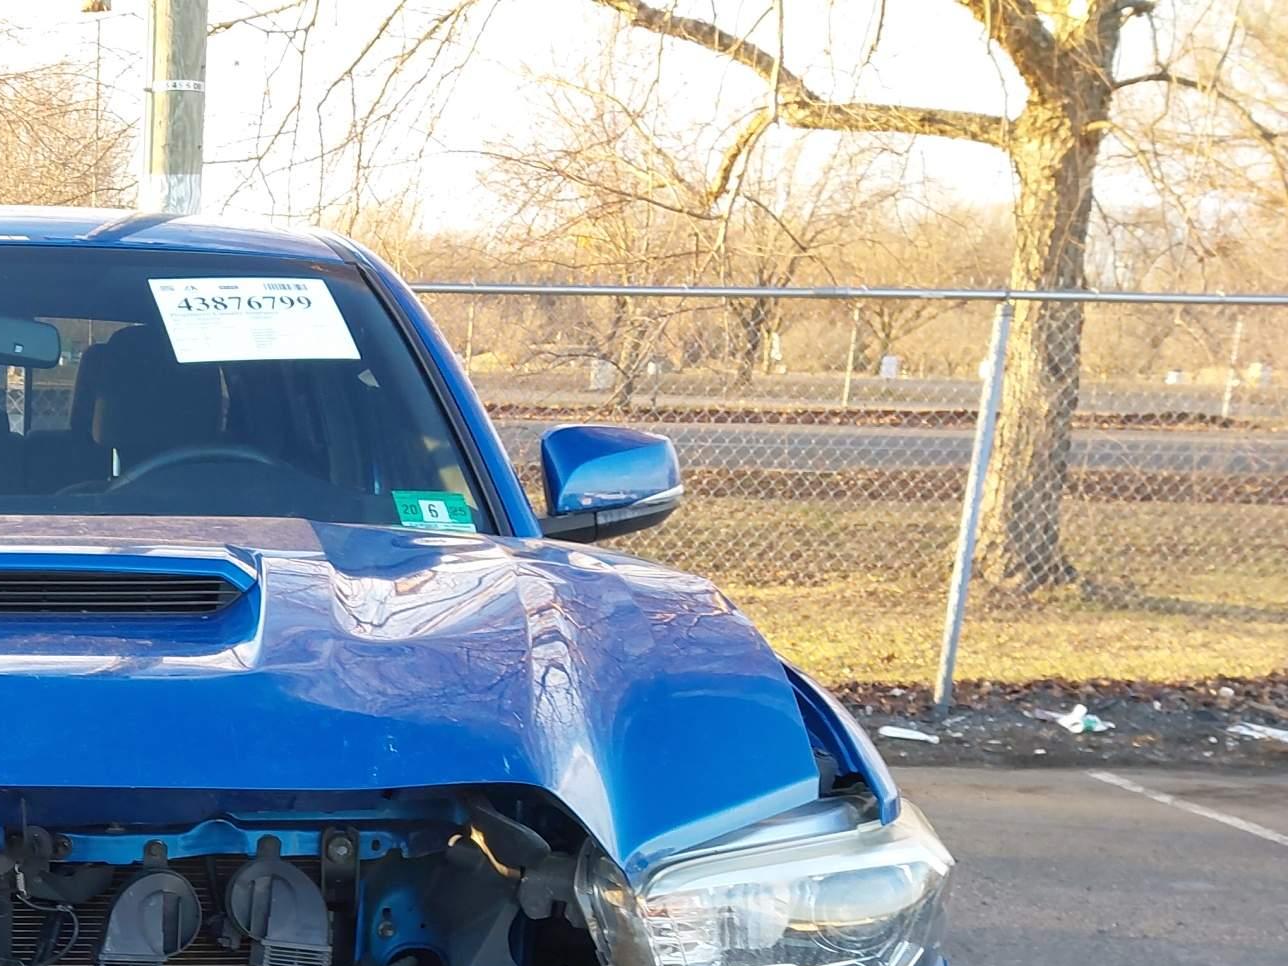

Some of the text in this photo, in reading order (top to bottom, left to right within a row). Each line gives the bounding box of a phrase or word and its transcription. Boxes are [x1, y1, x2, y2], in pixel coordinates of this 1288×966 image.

[177, 295, 313, 312] 43876799
[401, 504, 418, 515] 20
[428, 504, 439, 518] 6
